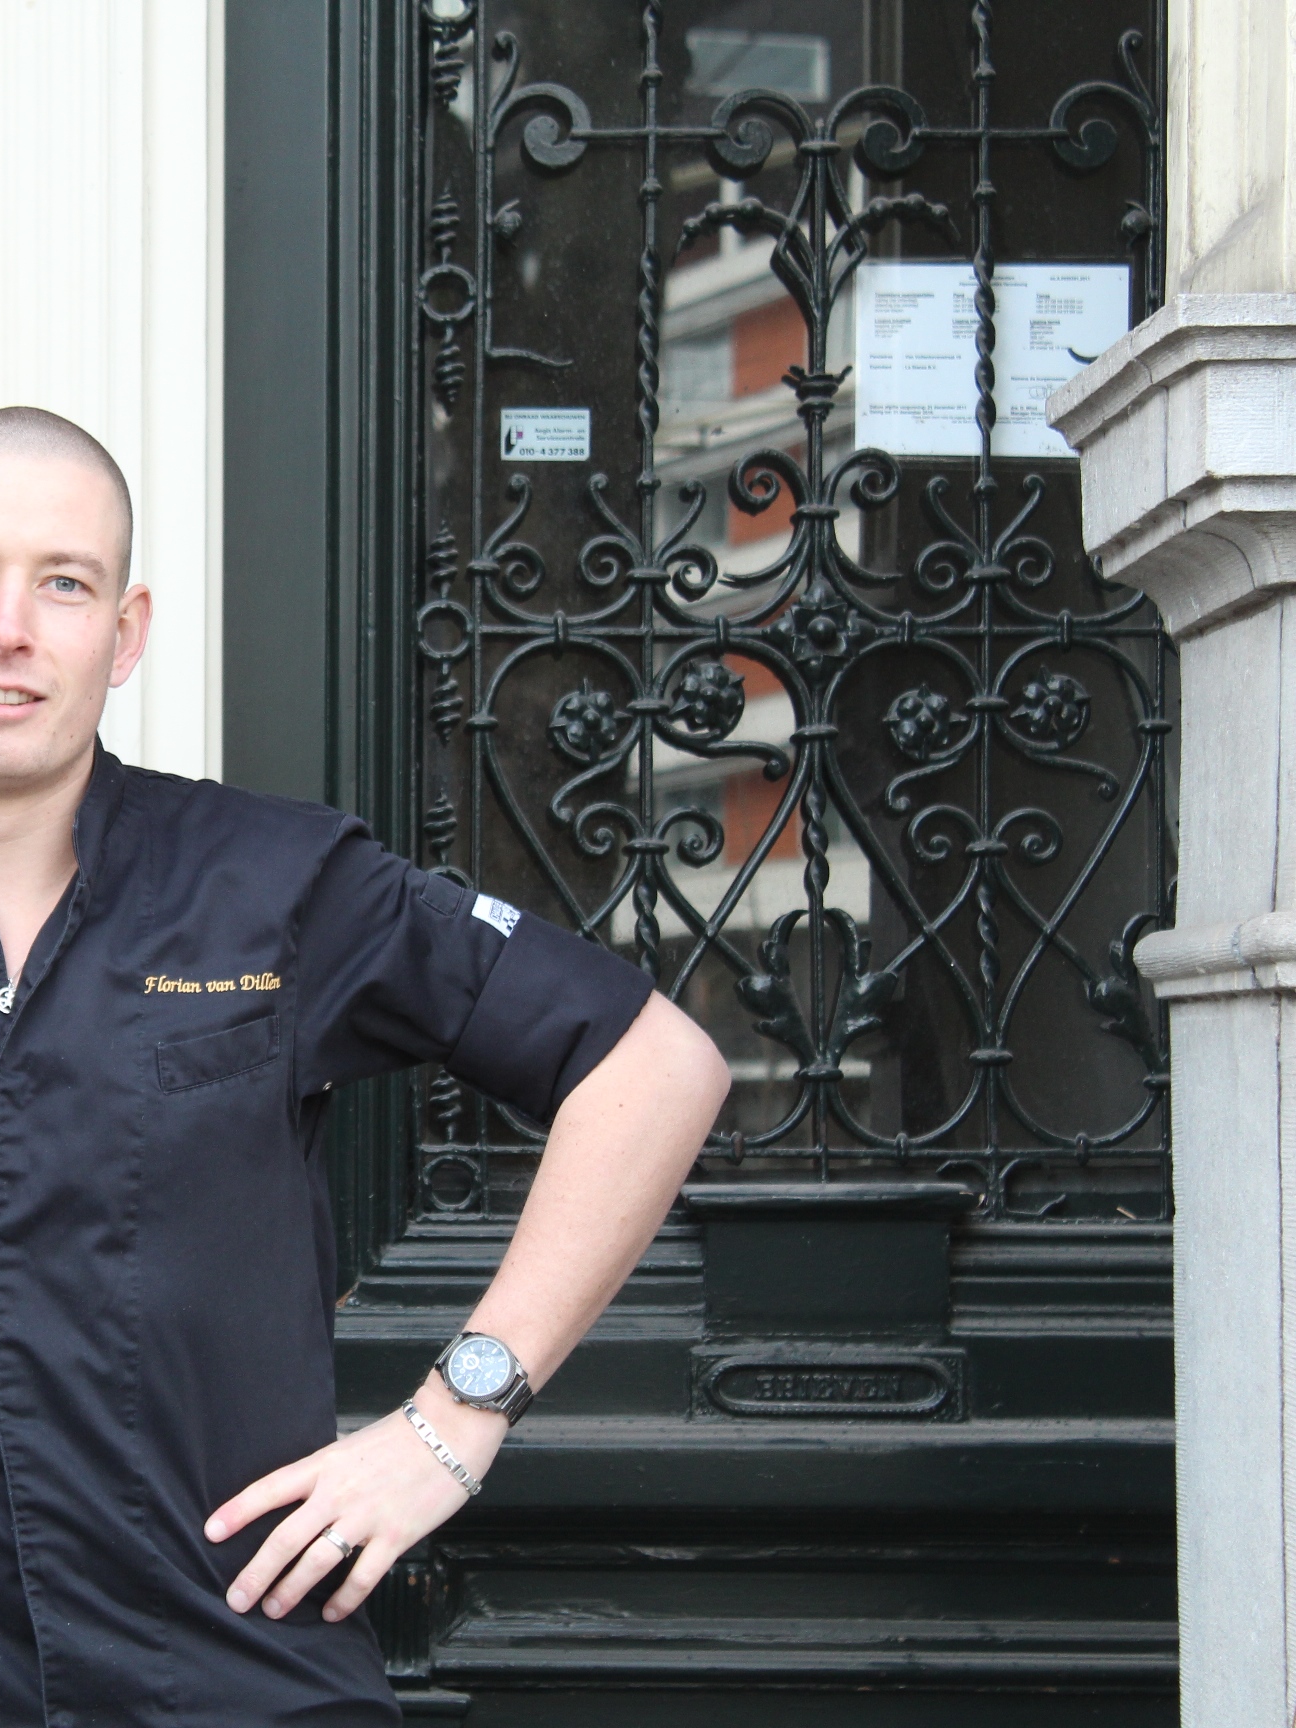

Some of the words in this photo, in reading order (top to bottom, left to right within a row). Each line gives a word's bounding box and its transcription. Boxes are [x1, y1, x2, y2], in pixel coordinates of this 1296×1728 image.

[548, 448, 565, 456] 377
[567, 448, 585, 456] 388
[144, 975, 202, 994] Florian
[205, 979, 236, 993] van
[240, 972, 281, 991] Dillen
